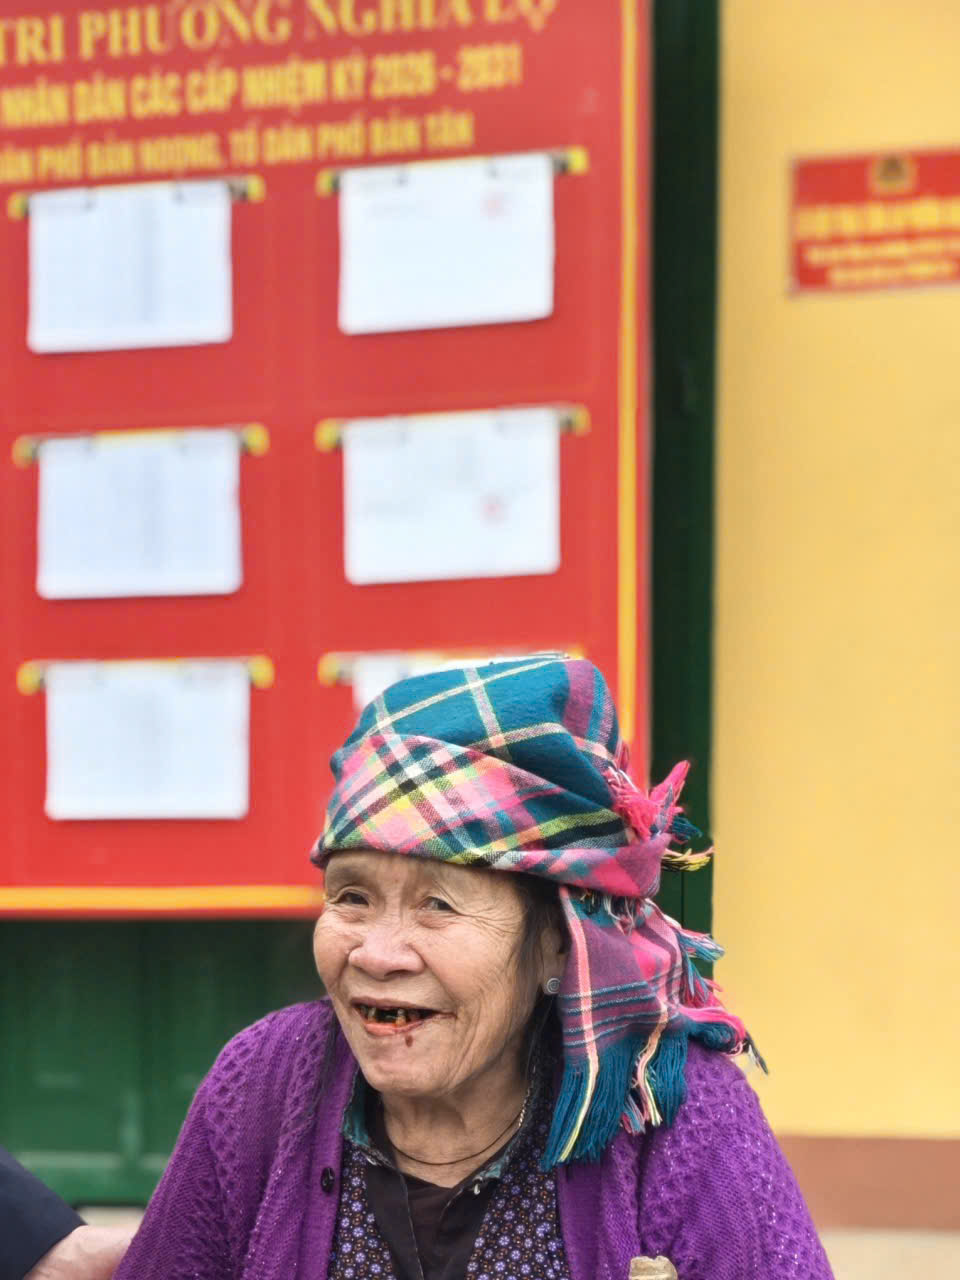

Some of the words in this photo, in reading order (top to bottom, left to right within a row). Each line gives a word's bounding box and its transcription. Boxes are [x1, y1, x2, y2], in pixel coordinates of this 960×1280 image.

[72, 69, 127, 123] DÂN
[129, 65, 182, 121] CÁC
[185, 54, 238, 115] CẤP
[241, 54, 326, 116] NHIỆM
[331, 48, 365, 103] KỲ
[37, 131, 82, 181] PHỐ
[317, 109, 364, 158] PHỐ
